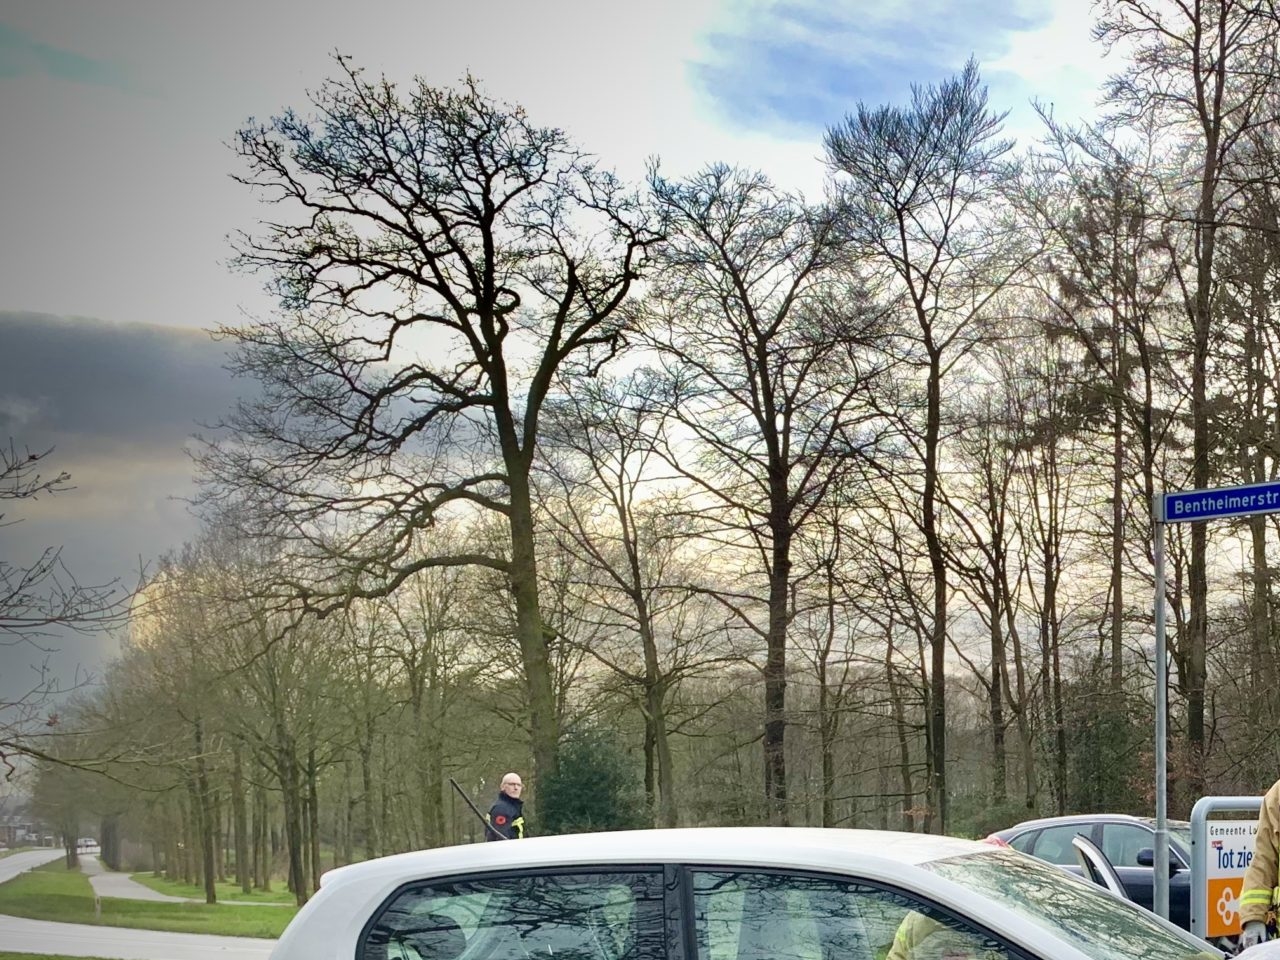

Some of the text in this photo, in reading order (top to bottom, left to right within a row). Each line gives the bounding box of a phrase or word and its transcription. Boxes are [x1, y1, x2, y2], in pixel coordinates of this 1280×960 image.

[1210, 825, 1259, 836] Gemeente Lo
[1216, 845, 1256, 869] Tot zie
